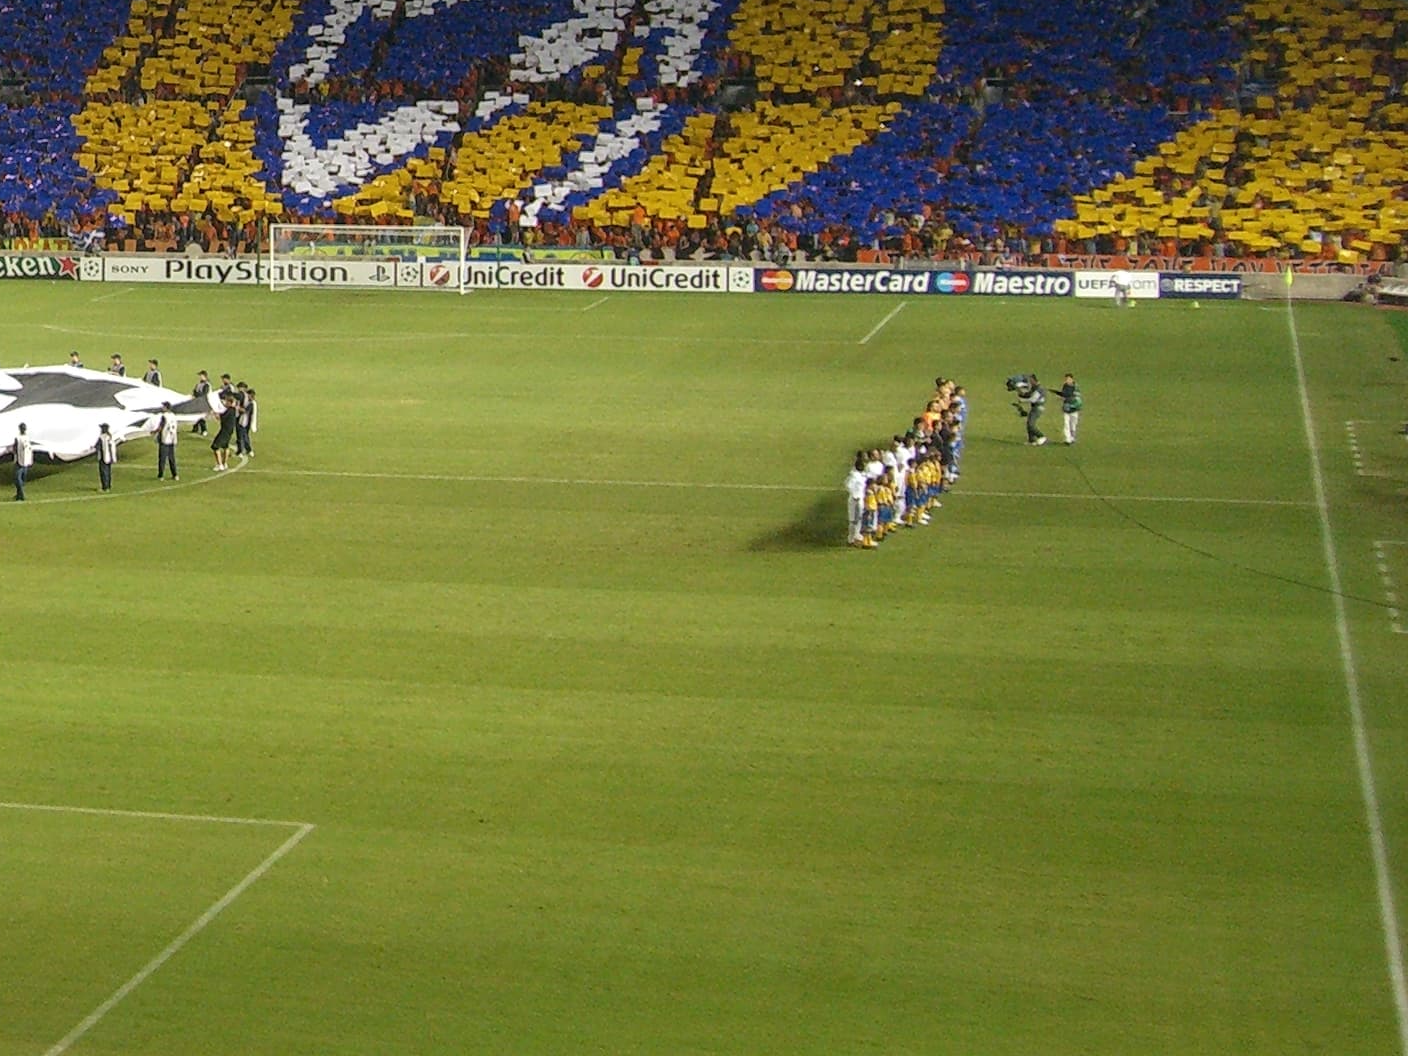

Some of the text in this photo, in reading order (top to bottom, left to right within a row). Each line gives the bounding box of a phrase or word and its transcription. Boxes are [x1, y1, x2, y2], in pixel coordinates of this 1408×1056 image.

[111, 260, 348, 283] SONY PlayStation
[458, 265, 565, 286] UniCredit
[612, 267, 720, 288] UniCredit
[796, 271, 1071, 294] MasterCard Maestro
[1174, 279, 1241, 293] RESPECT
